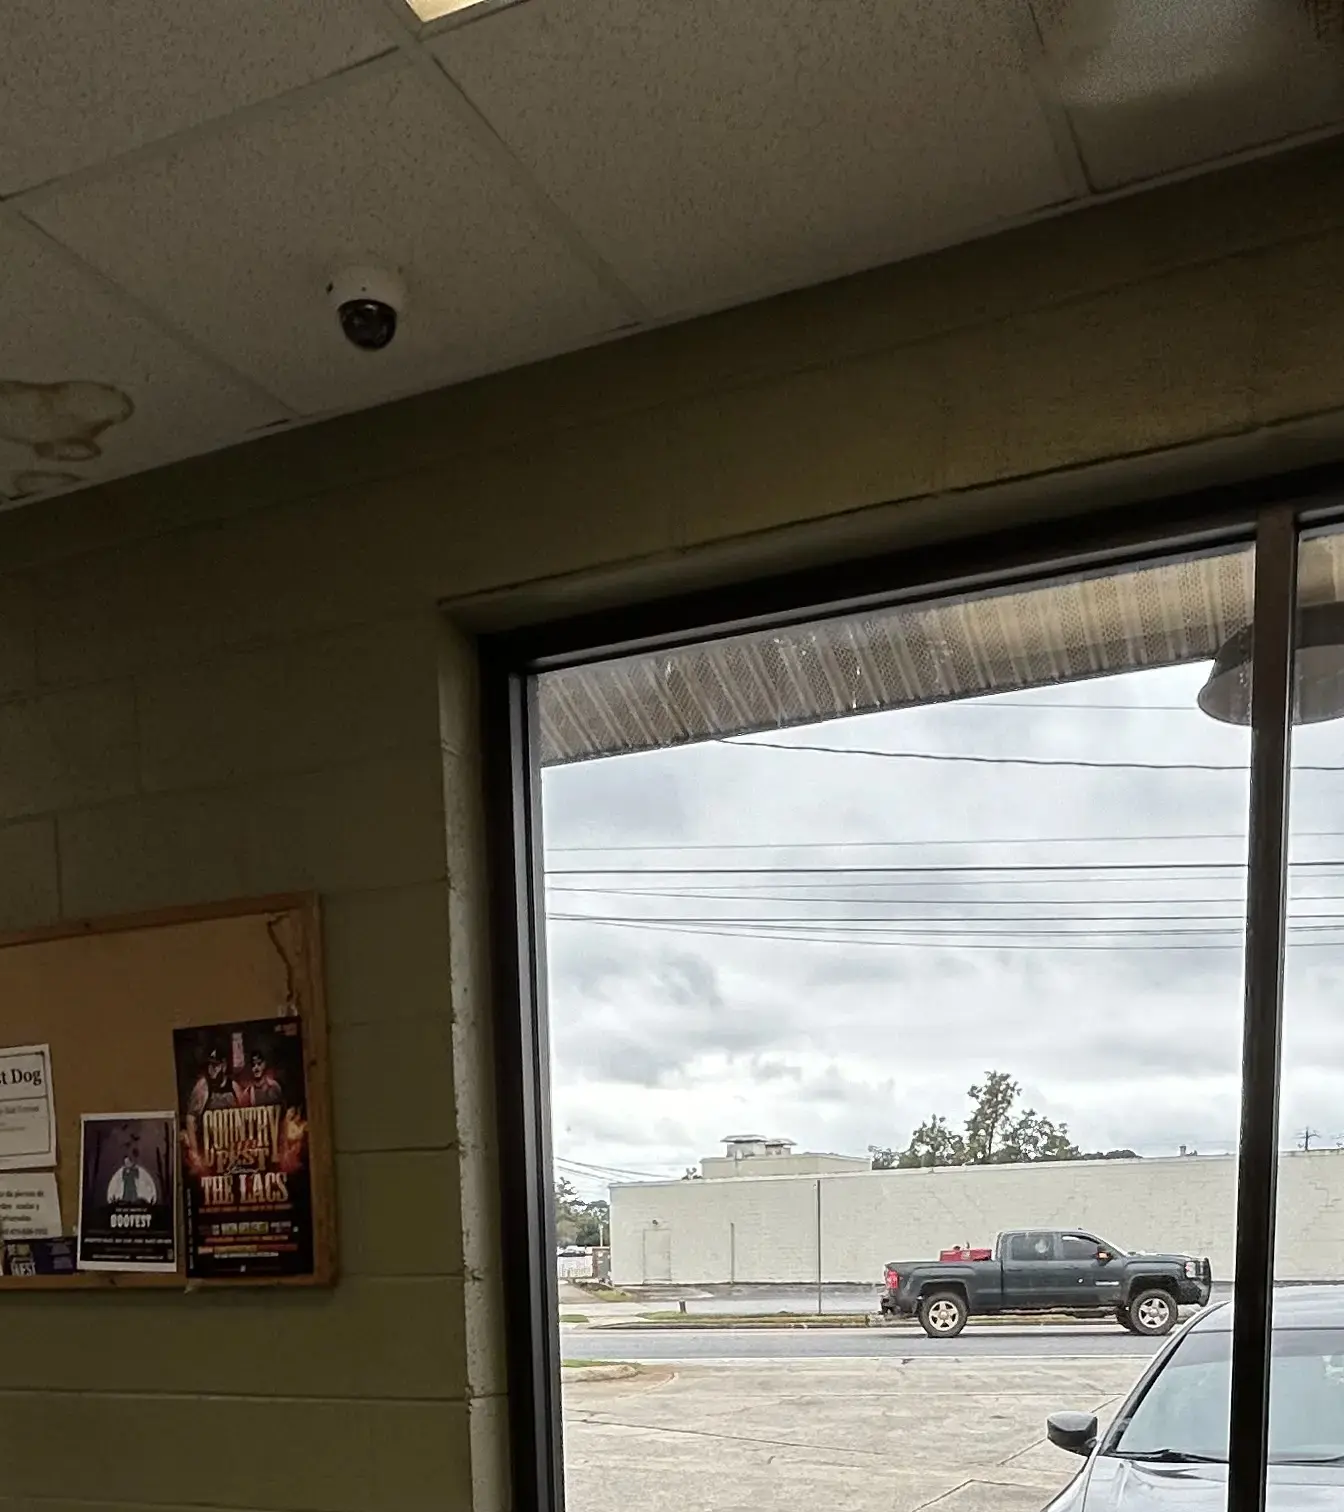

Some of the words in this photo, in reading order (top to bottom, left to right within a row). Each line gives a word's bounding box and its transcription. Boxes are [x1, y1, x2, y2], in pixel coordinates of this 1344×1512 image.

[11, 1068, 42, 1086] Dog
[202, 1104, 283, 1166] COUNTRY
[201, 1175, 234, 1206] THE
[238, 1172, 289, 1204] LACS
